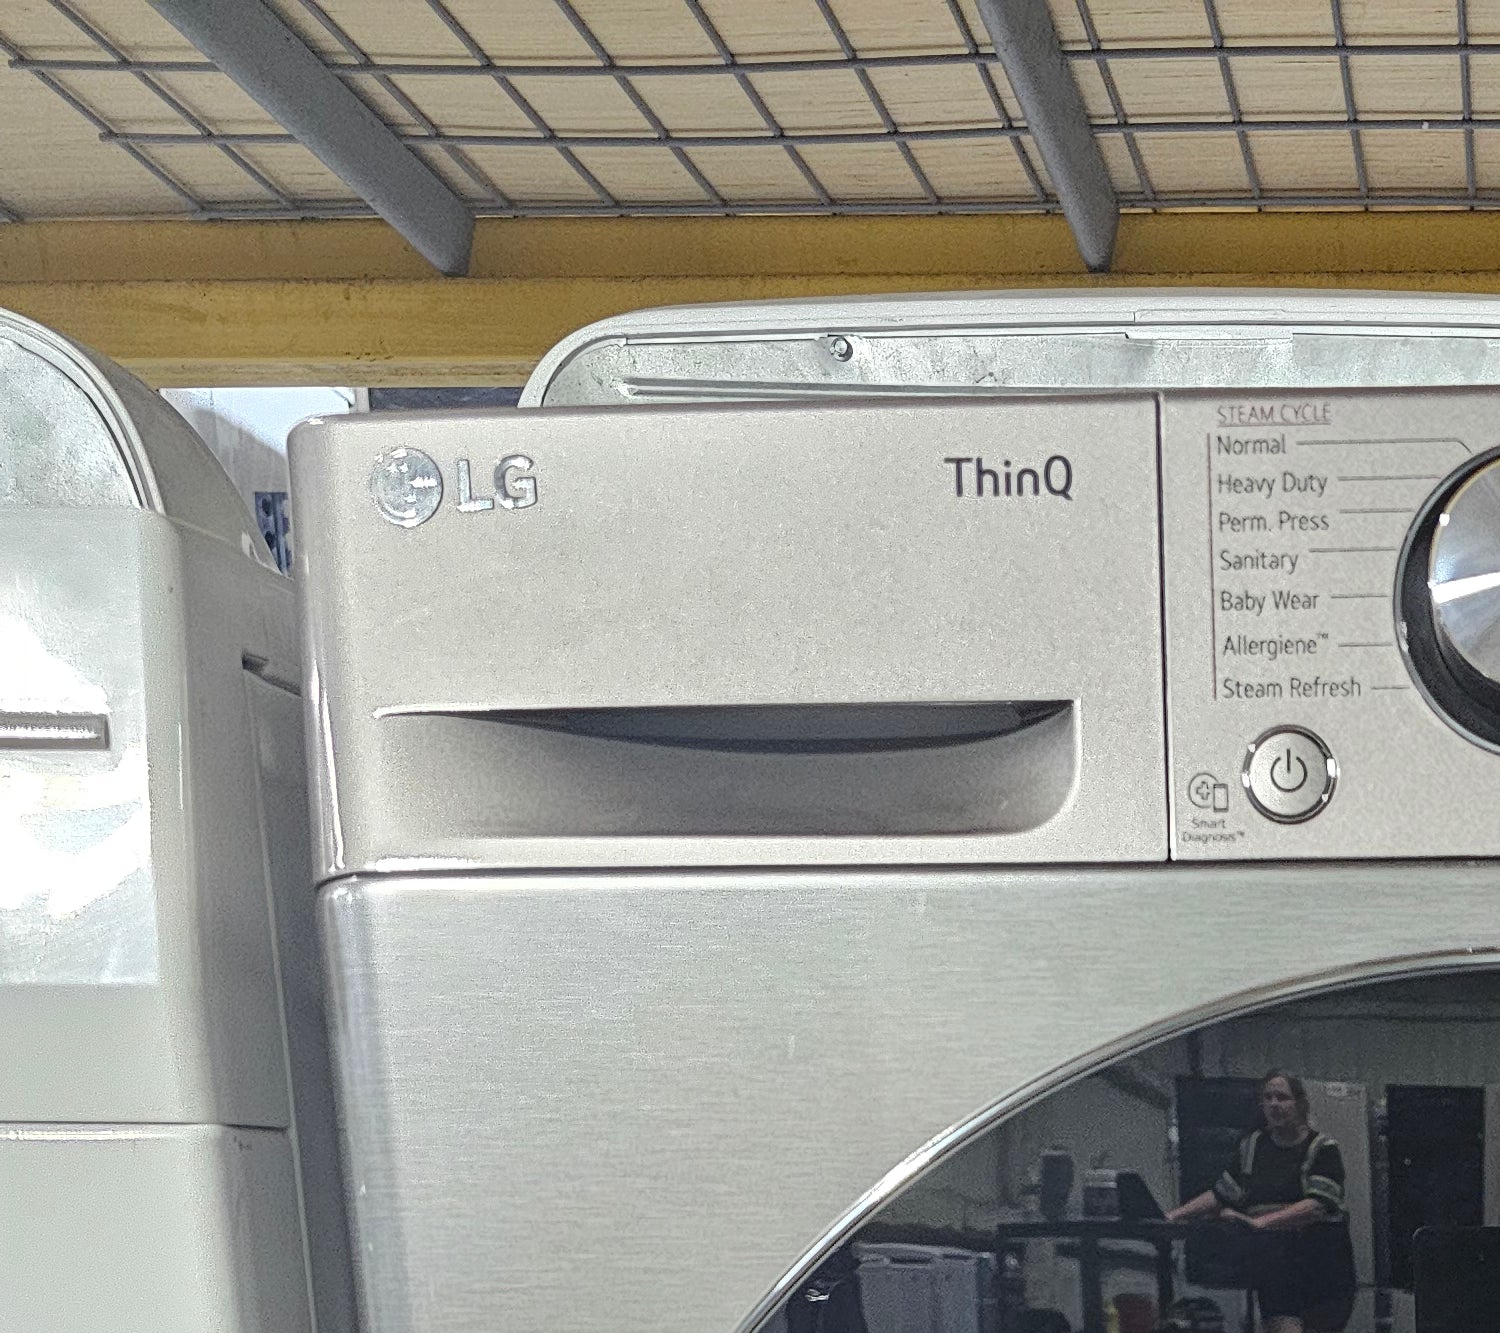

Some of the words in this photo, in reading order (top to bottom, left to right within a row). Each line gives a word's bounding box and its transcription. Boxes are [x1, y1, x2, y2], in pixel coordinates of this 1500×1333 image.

[1217, 404, 1275, 424] STEAM
[1280, 403, 1331, 422] CYCLE
[1217, 434, 1286, 455] Normal
[456, 454, 538, 512] LG
[943, 454, 1073, 501] ThinQ
[1217, 473, 1275, 498] Heavy
[1282, 471, 1328, 498] Duty
[1219, 511, 1273, 533] Perm.
[1279, 510, 1330, 531] Press
[1220, 549, 1299, 575] Sanitary
[1220, 590, 1265, 616] Baby
[1272, 589, 1320, 611] Wear
[1223, 677, 1283, 699] Steam
[1290, 676, 1361, 698] Refresh
[1191, 818, 1226, 829] Smart
